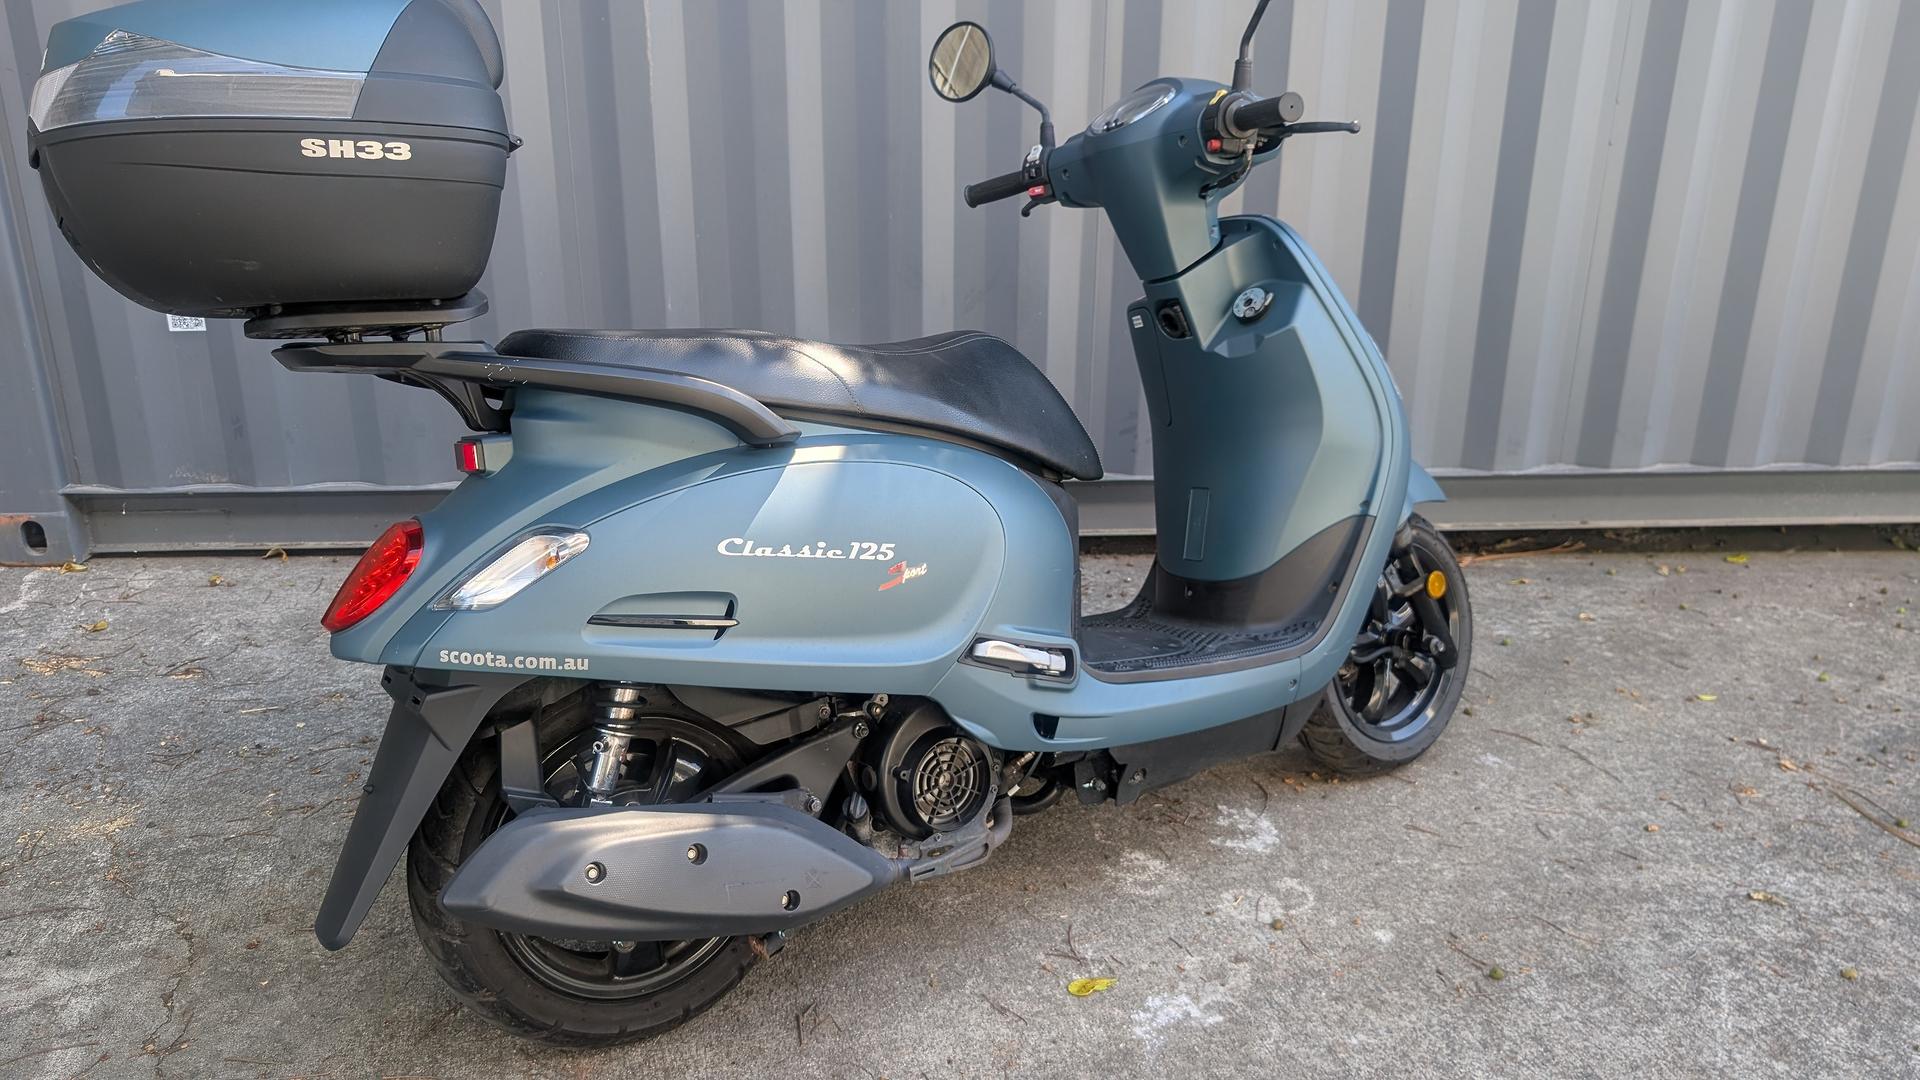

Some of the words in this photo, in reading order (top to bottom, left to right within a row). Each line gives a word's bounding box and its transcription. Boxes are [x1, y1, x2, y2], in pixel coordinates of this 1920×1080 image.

[300, 138, 412, 160] SH33
[716, 537, 847, 559] Classic
[848, 541, 896, 561] 125
[878, 560, 928, 592] Sport
[439, 649, 589, 671] scoota.com.au
